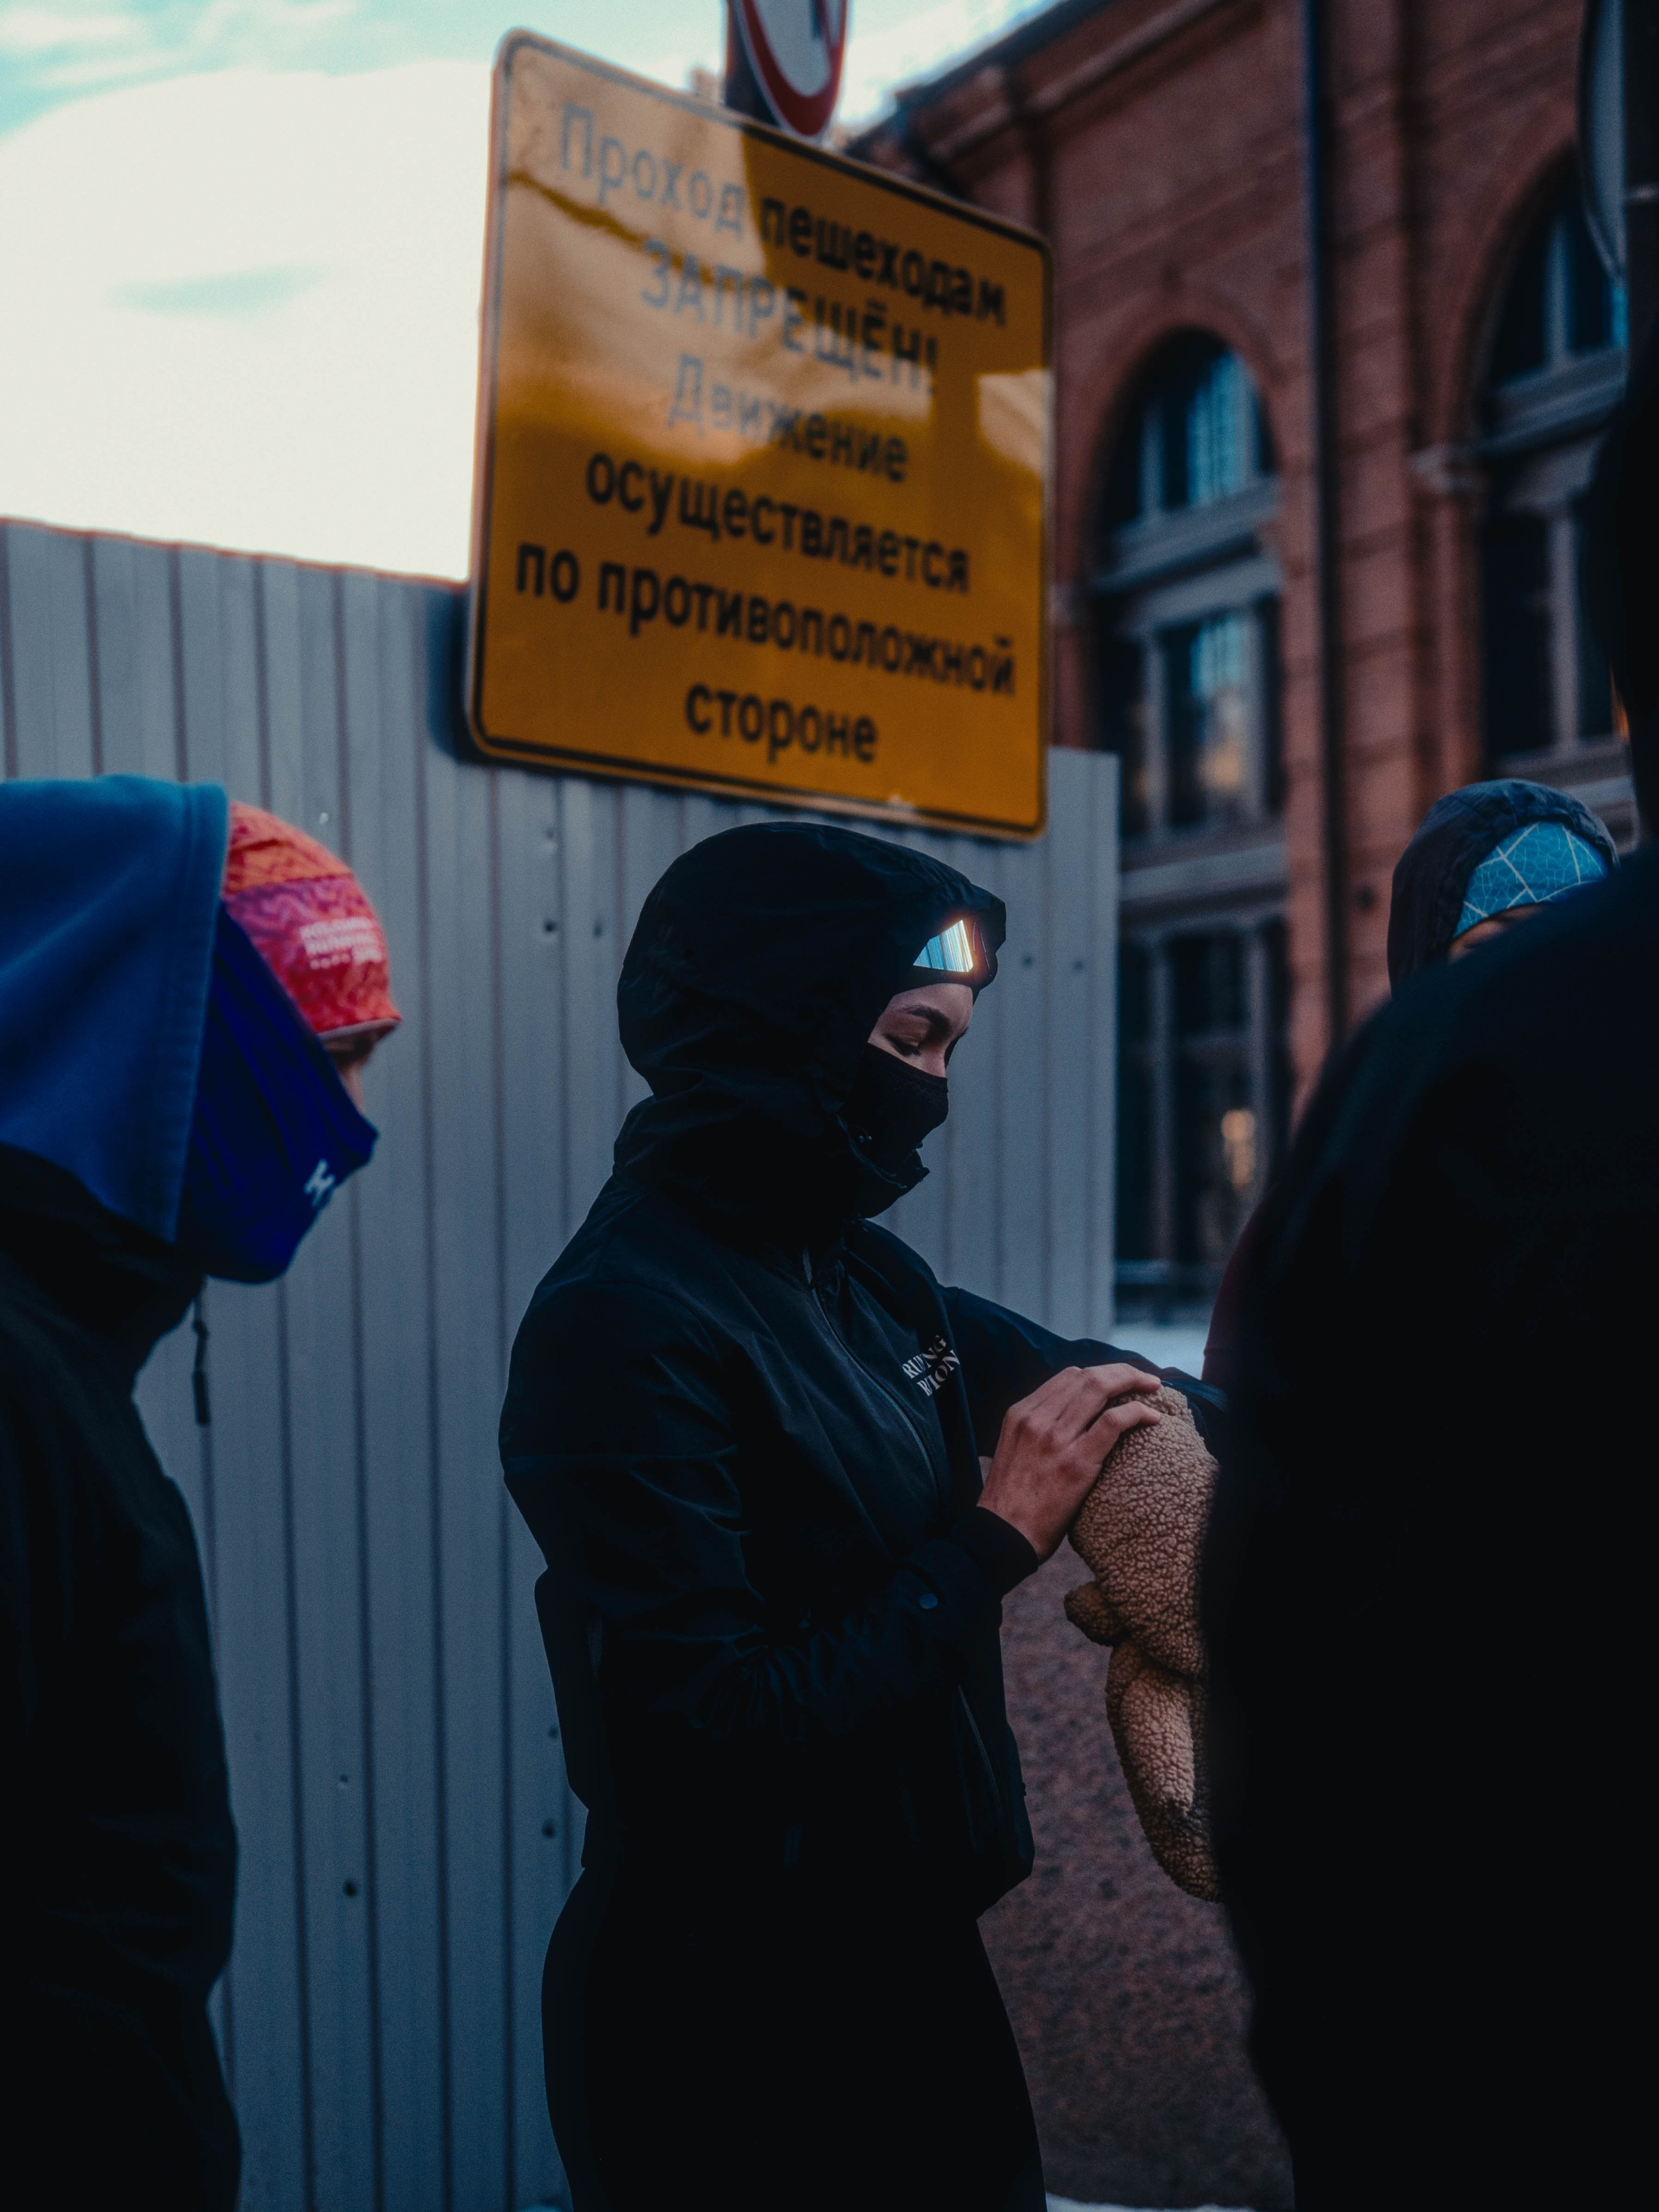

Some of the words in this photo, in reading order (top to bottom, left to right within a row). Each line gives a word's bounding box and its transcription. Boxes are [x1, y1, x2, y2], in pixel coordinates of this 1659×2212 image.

[558, 100, 747, 245] Проход
[759, 196, 1008, 328] пешеходам
[667, 353, 909, 483] Движение
[585, 450, 971, 594] осуществляется
[516, 542, 581, 603] по
[597, 560, 1017, 697] противоположной
[685, 682, 877, 765] стороне
